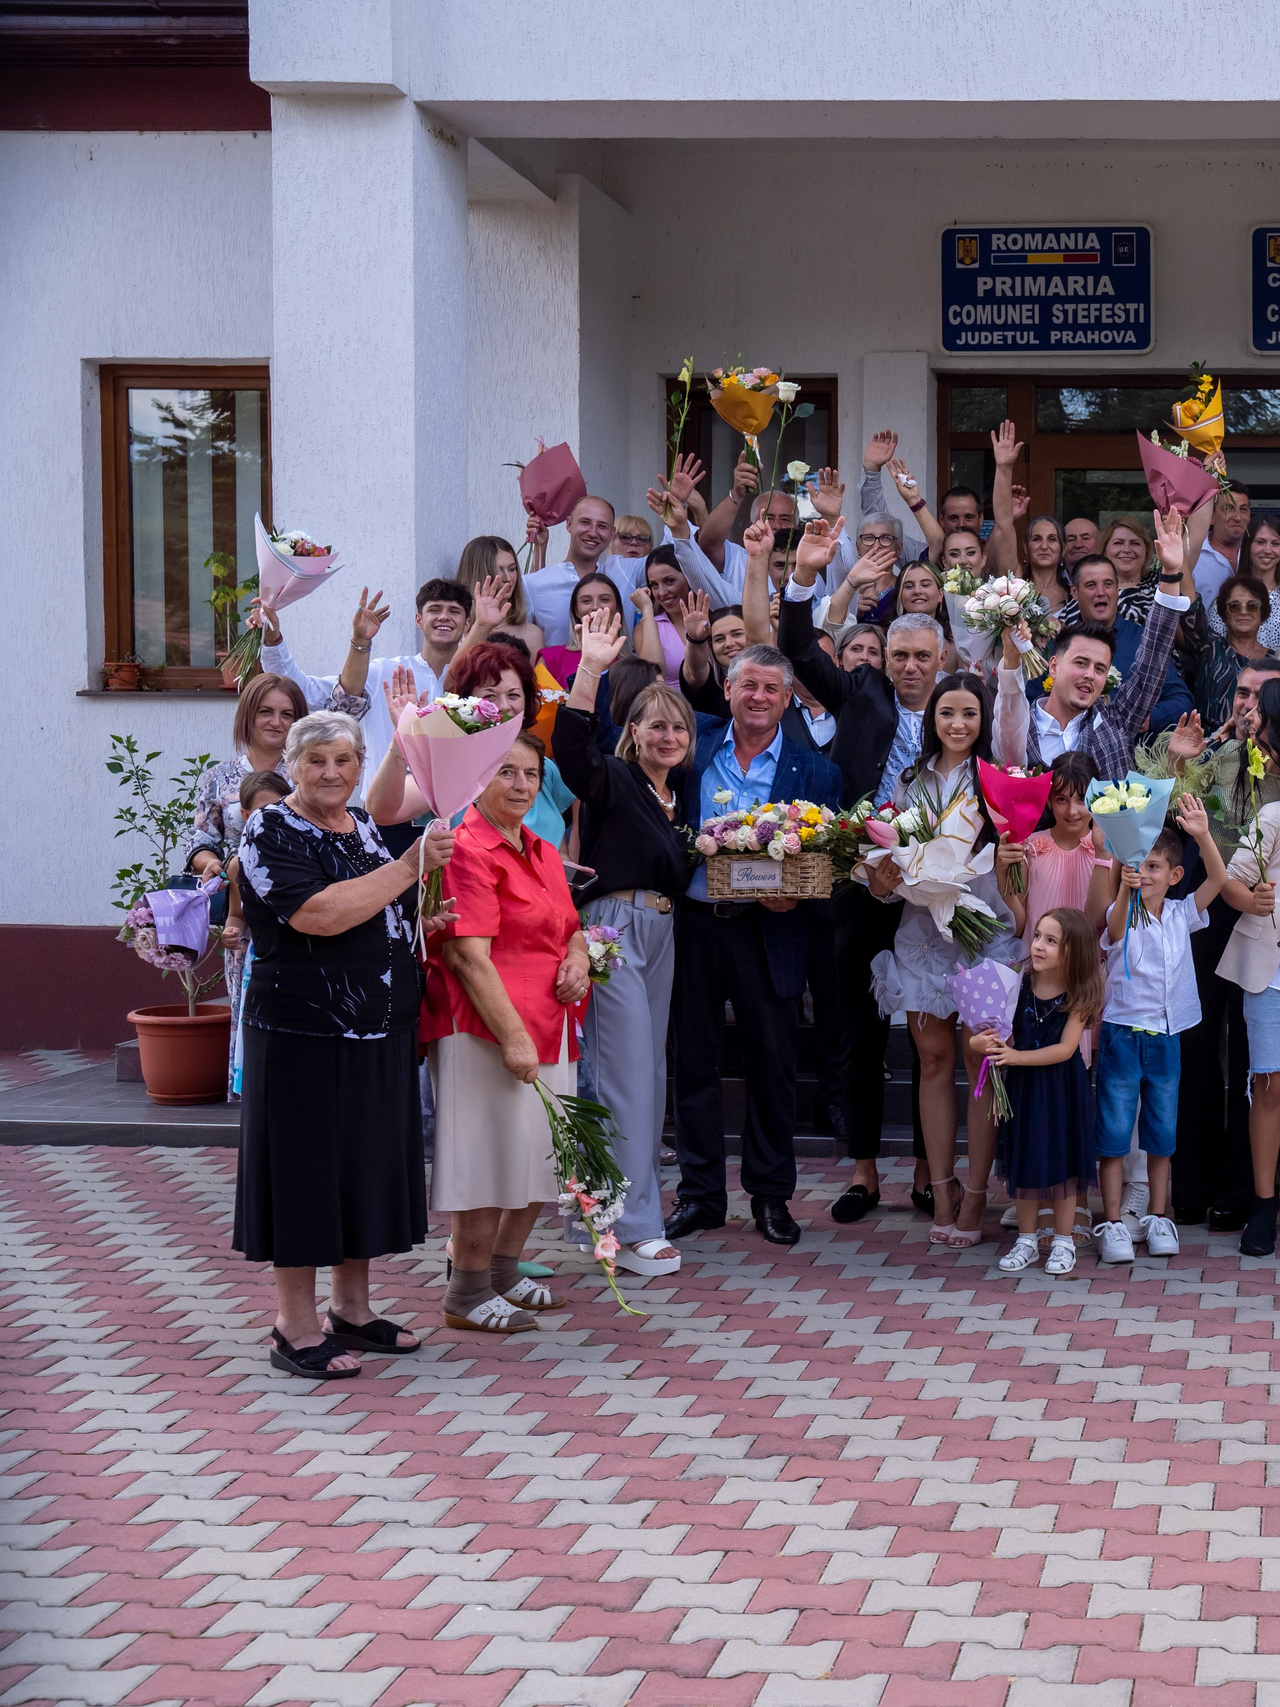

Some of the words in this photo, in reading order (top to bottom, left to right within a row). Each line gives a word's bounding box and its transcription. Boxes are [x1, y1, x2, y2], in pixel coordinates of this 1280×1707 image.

[991, 232, 1101, 250] ROMANIA
[976, 275, 1115, 297] PRIMARIA
[948, 304, 1040, 325] COMUNEI
[1051, 303, 1145, 325] STEFESTI
[955, 331, 1040, 345] JUDETUL
[1050, 330, 1137, 345] PRAHOVA
[736, 867, 777, 882] Flowers
